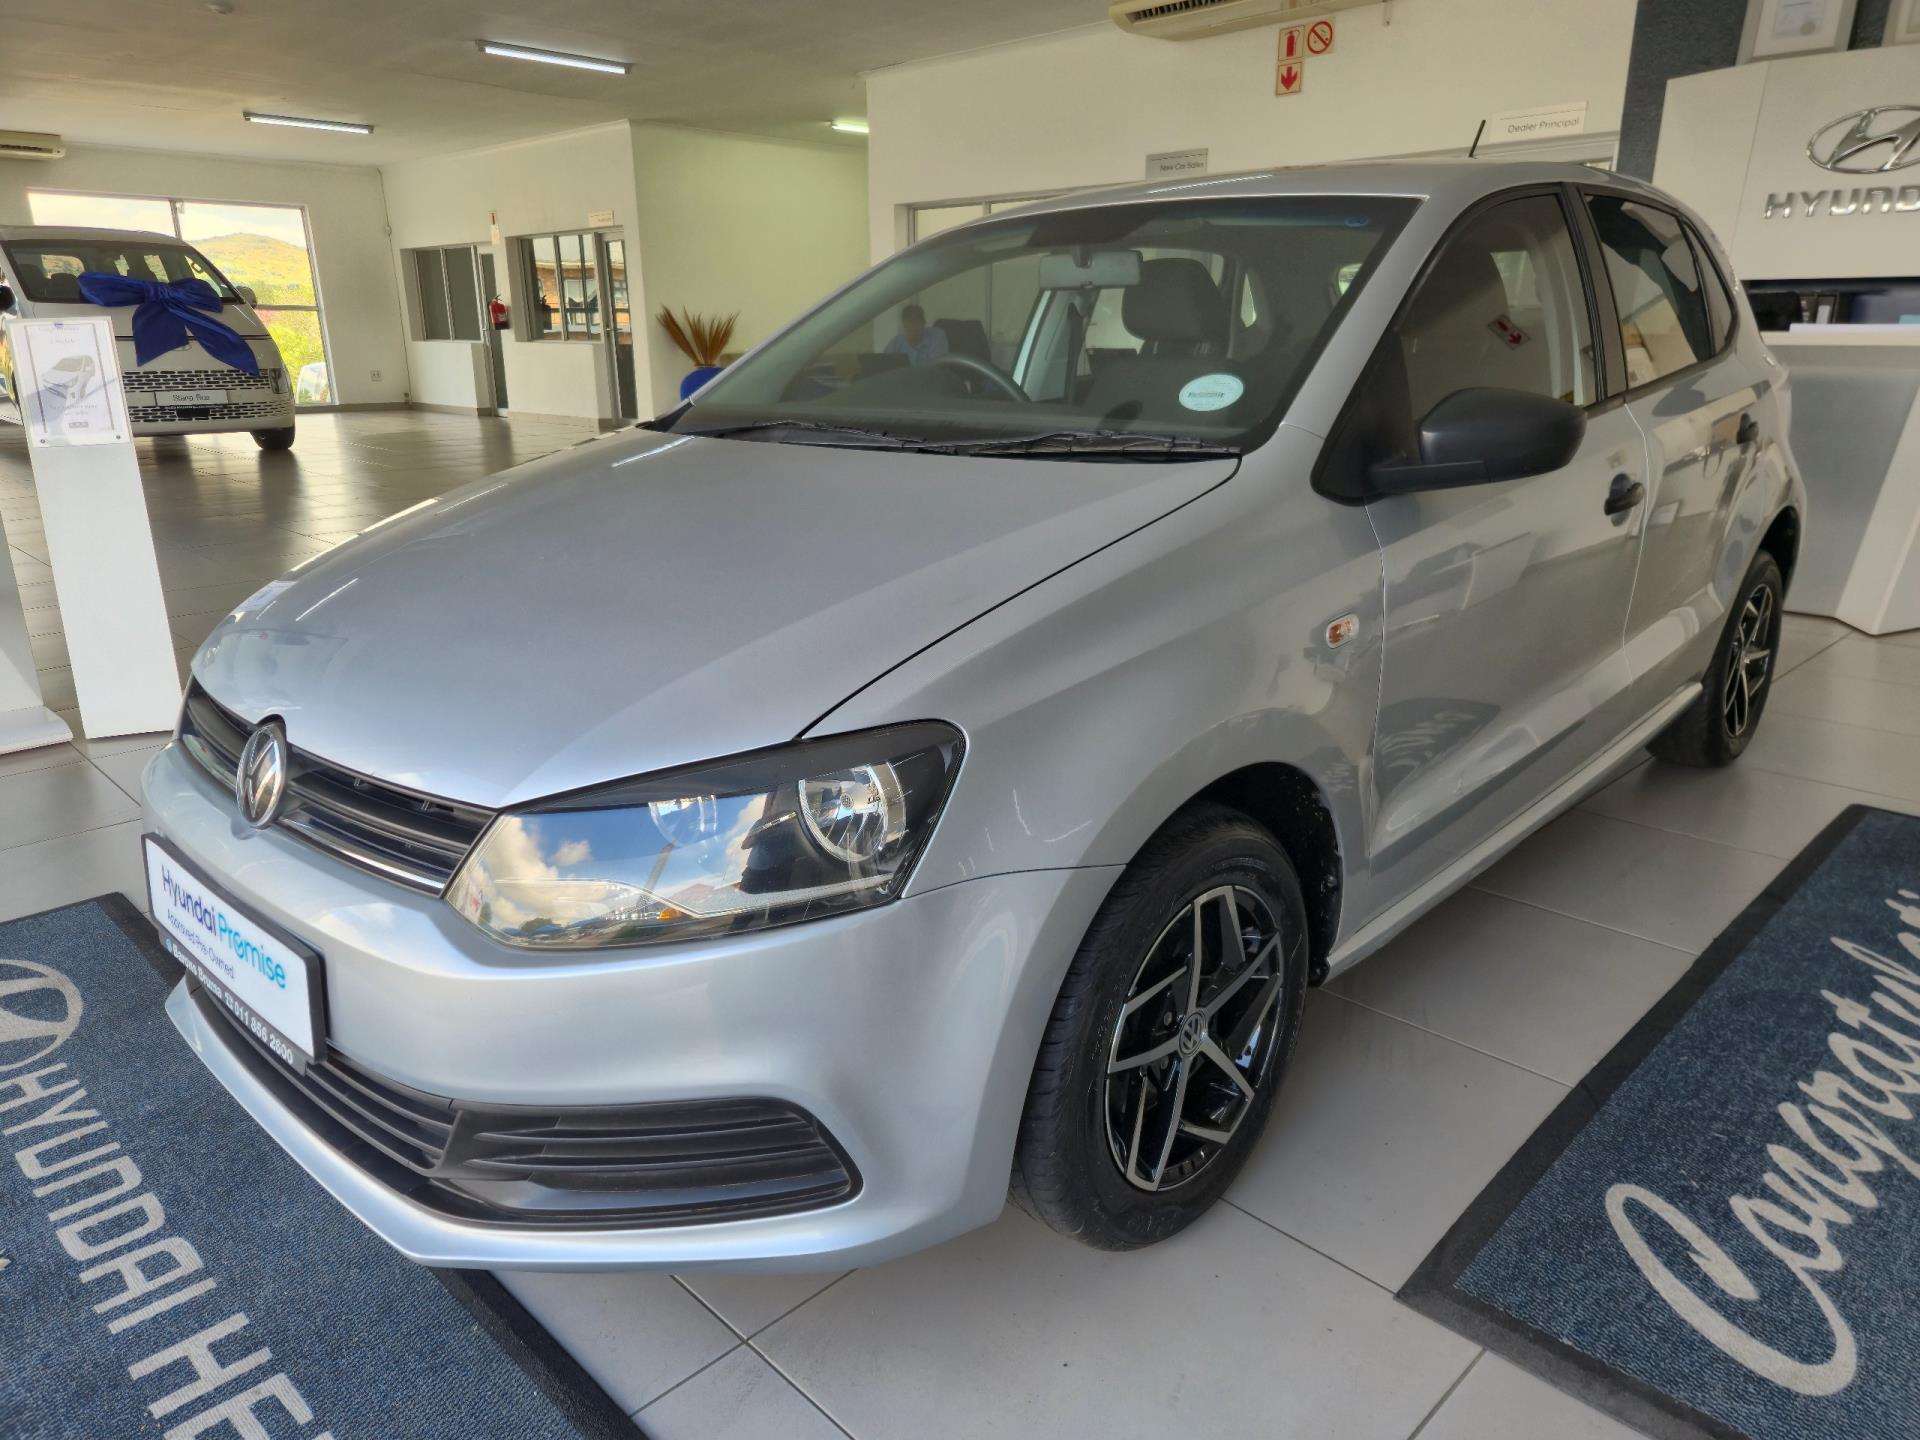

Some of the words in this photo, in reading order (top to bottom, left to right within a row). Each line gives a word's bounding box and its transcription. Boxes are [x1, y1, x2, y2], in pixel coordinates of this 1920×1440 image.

[1507, 123, 1536, 134] Dealer
[1538, 116, 1580, 129] Principal
[161, 864, 217, 936] Hyundai
[217, 912, 286, 990] Promise
[234, 1001, 249, 1026] 011
[0, 1062, 217, 1335] HYUNDAI
